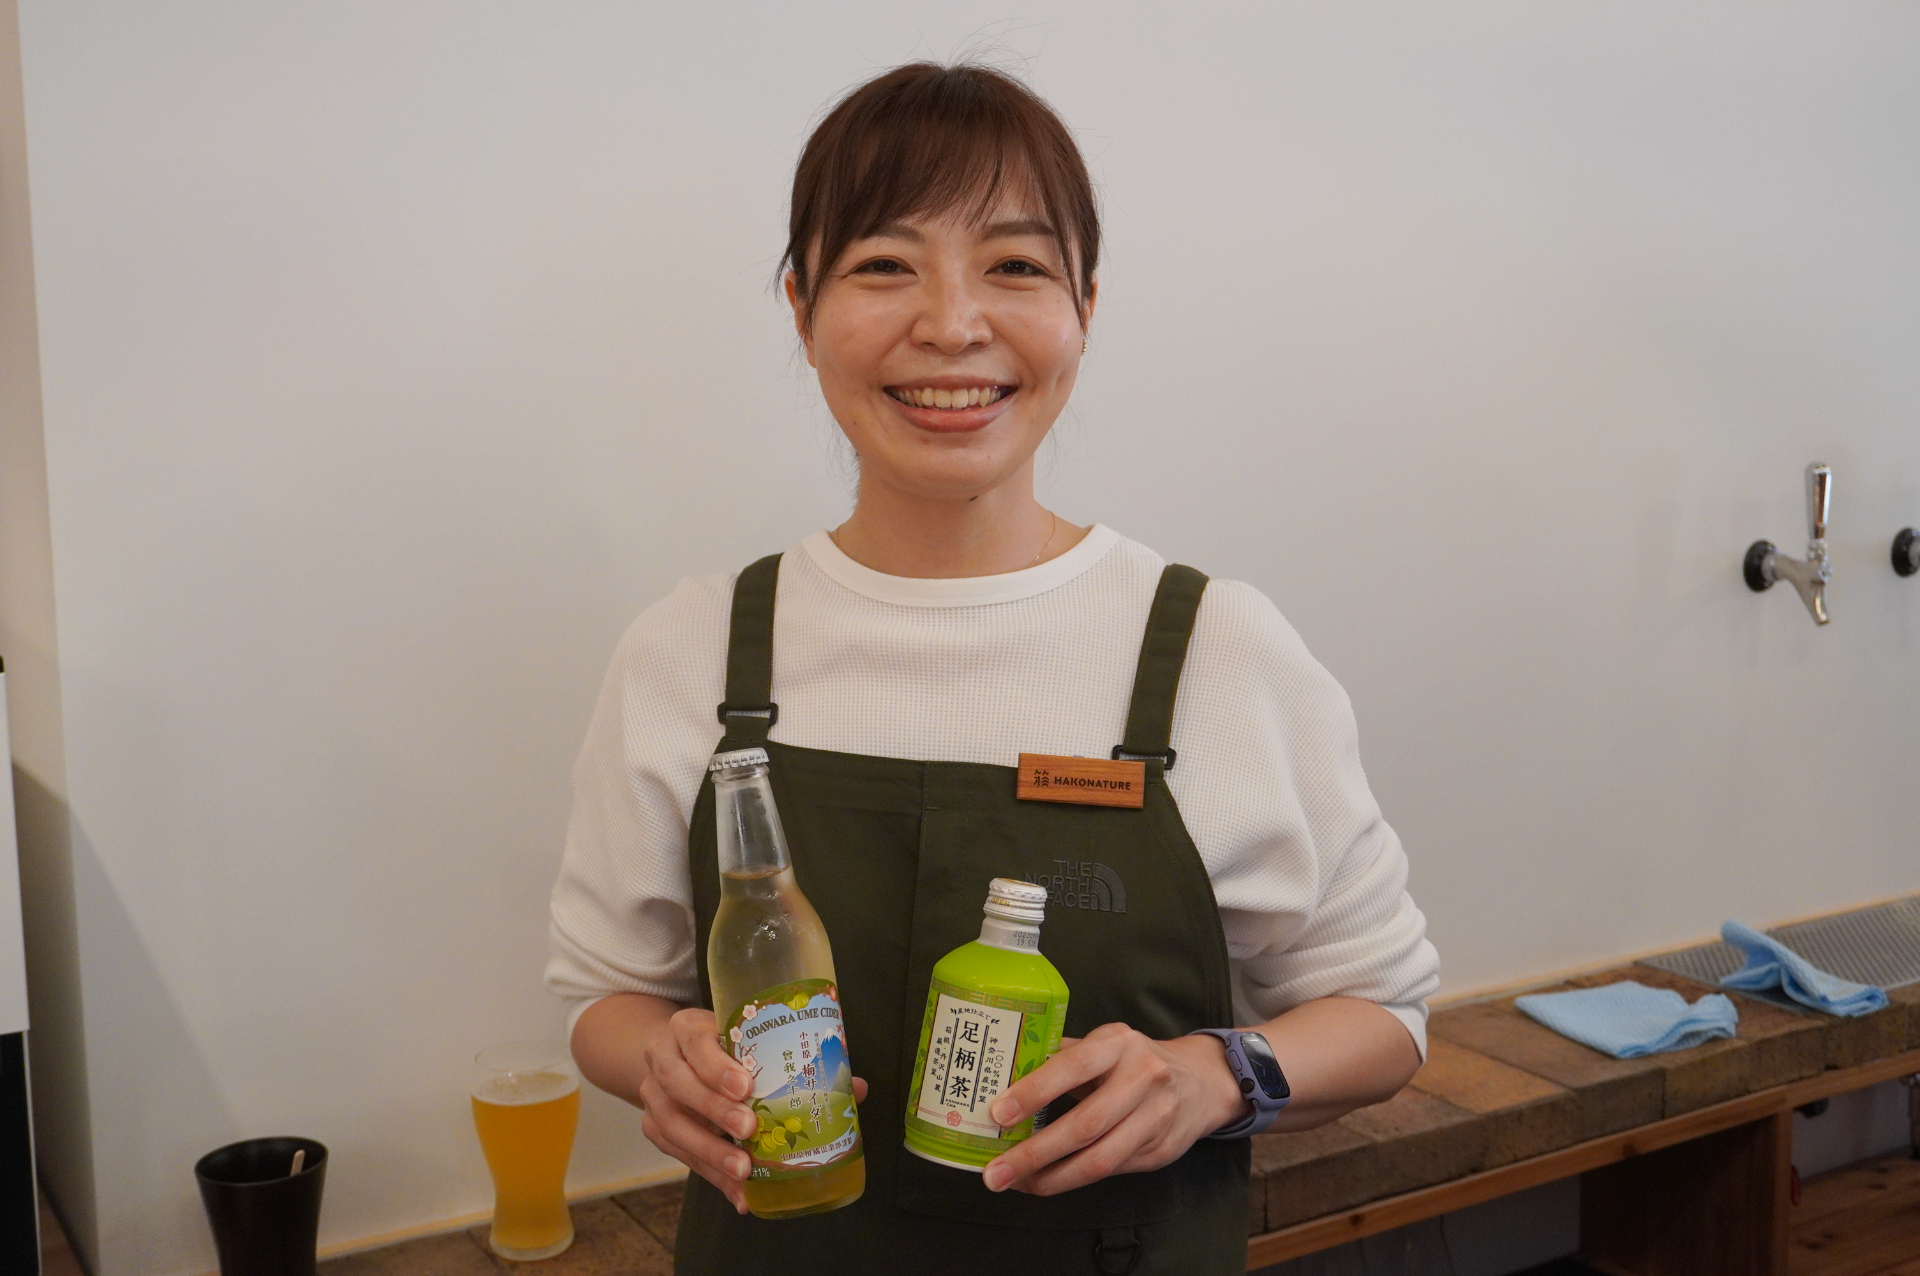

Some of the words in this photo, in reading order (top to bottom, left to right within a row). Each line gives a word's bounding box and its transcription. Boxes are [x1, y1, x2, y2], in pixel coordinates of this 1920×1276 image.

[1054, 776, 1131, 791] HAKONATURE
[1053, 859, 1093, 877] THE
[990, 896, 1010, 907] OPEN
[745, 1013, 796, 1040] ODAWARA
[796, 1008, 819, 1021] UME
[820, 1007, 840, 1020] CIDER
[949, 1020, 980, 1099] 足柄茶
[977, 1036, 999, 1104] 神奈川県産茶葉
